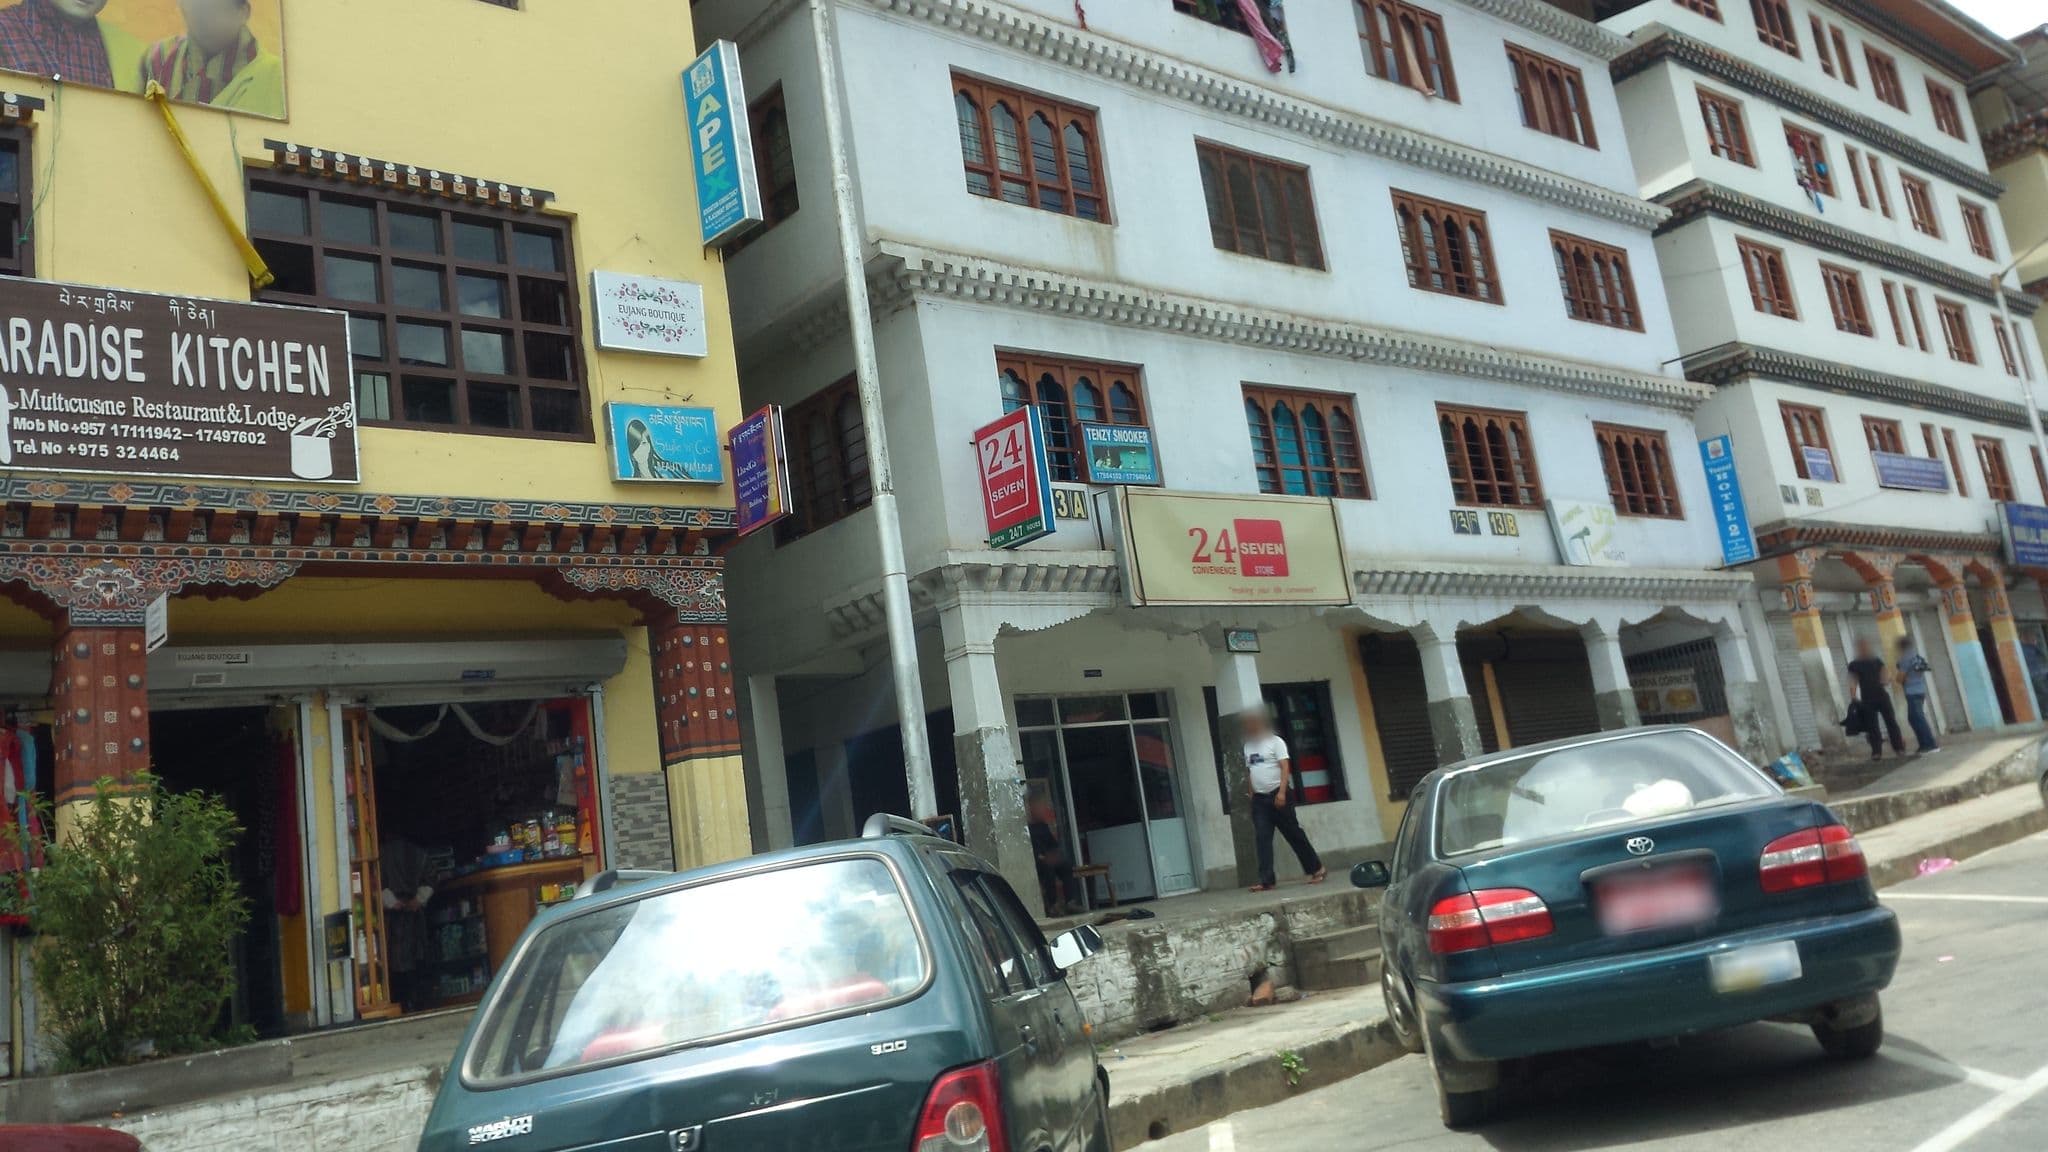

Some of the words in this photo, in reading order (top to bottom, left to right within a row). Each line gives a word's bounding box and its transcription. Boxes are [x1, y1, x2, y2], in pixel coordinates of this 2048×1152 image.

[696, 93, 731, 200] APEX
[618, 303, 647, 317] EUJANG
[647, 307, 687, 323] BOUTIQUE
[171, 330, 331, 397] KITCHEN
[13, 416, 46, 433] Mob
[47, 419, 70, 434] No
[1086, 427, 1112, 441] TENZY
[1112, 430, 1150, 444] SNOOKER
[13, 438, 38, 455] Tel
[41, 441, 63, 456] No
[67, 443, 109, 458] +975
[115, 445, 180, 461] 324464
[985, 428, 1023, 476] 24
[991, 479, 1025, 503] SEVEN
[1008, 524, 1023, 540] 24/7
[1188, 527, 1237, 563] 24
[1239, 543, 1284, 556] SEVEN
[1192, 566, 1237, 576] CONVENIENCE
[1254, 565, 1275, 575] STORE
